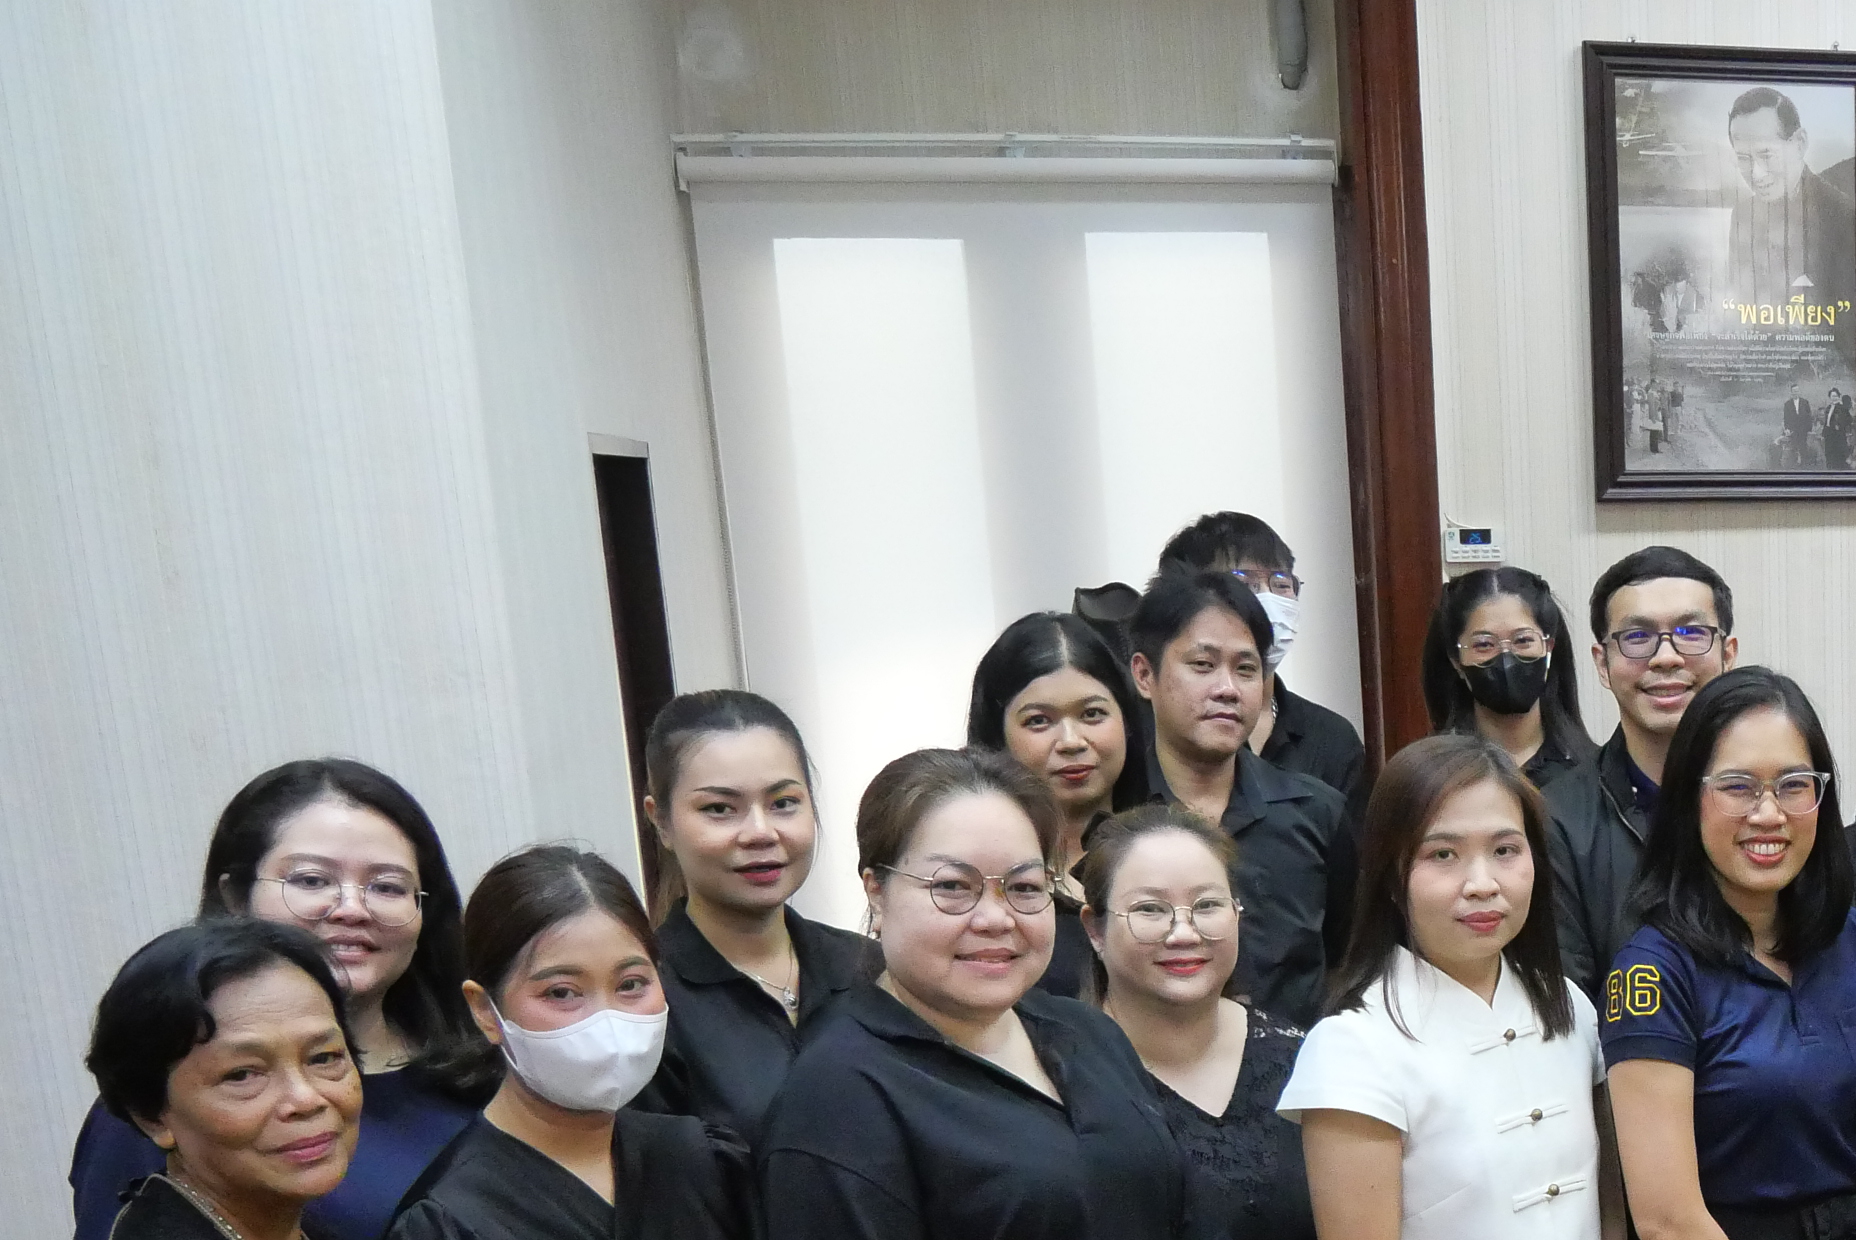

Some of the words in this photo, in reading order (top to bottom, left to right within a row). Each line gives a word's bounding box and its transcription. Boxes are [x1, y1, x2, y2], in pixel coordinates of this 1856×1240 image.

[1722, 294, 1851, 326] “พอเพียง”
[1606, 964, 1661, 1022] 86
